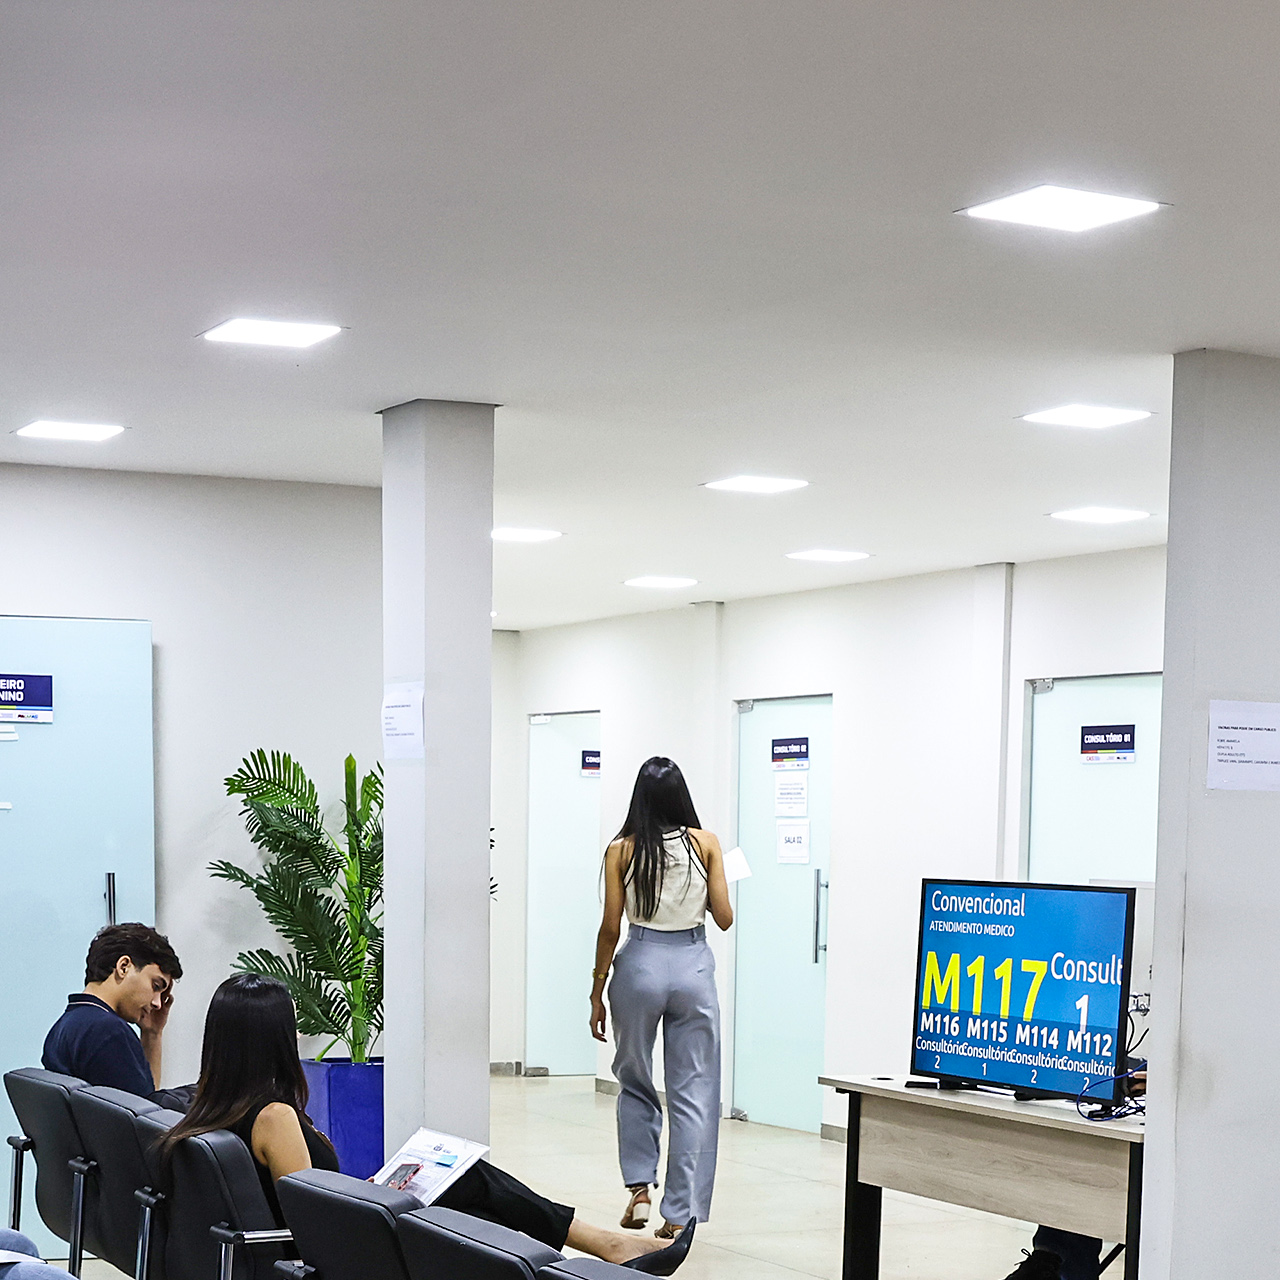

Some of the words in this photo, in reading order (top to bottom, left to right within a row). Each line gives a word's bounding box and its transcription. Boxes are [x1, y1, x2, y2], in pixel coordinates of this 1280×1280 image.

[931, 890, 1025, 916] Convencional
[929, 920, 983, 935] ATENDIMENTO
[983, 922, 1015, 937] MEDICO
[922, 951, 1048, 1022] M117
[1051, 952, 1123, 985] Consult
[1075, 994, 1089, 1035] 1
[915, 1036, 964, 1056] Consultório
[962, 1042, 1012, 1063] Consultório
[1010, 1049, 1064, 1070] Consultório
[920, 1012, 960, 1037] M116
[966, 1017, 1008, 1043] M115
[1015, 1023, 1059, 1050] M114
[1066, 1030, 1113, 1057] M112
[934, 1055, 941, 1069] 2
[981, 1062, 987, 1076] 1
[1031, 1069, 1038, 1084] 2
[1083, 1076, 1090, 1092] 2
